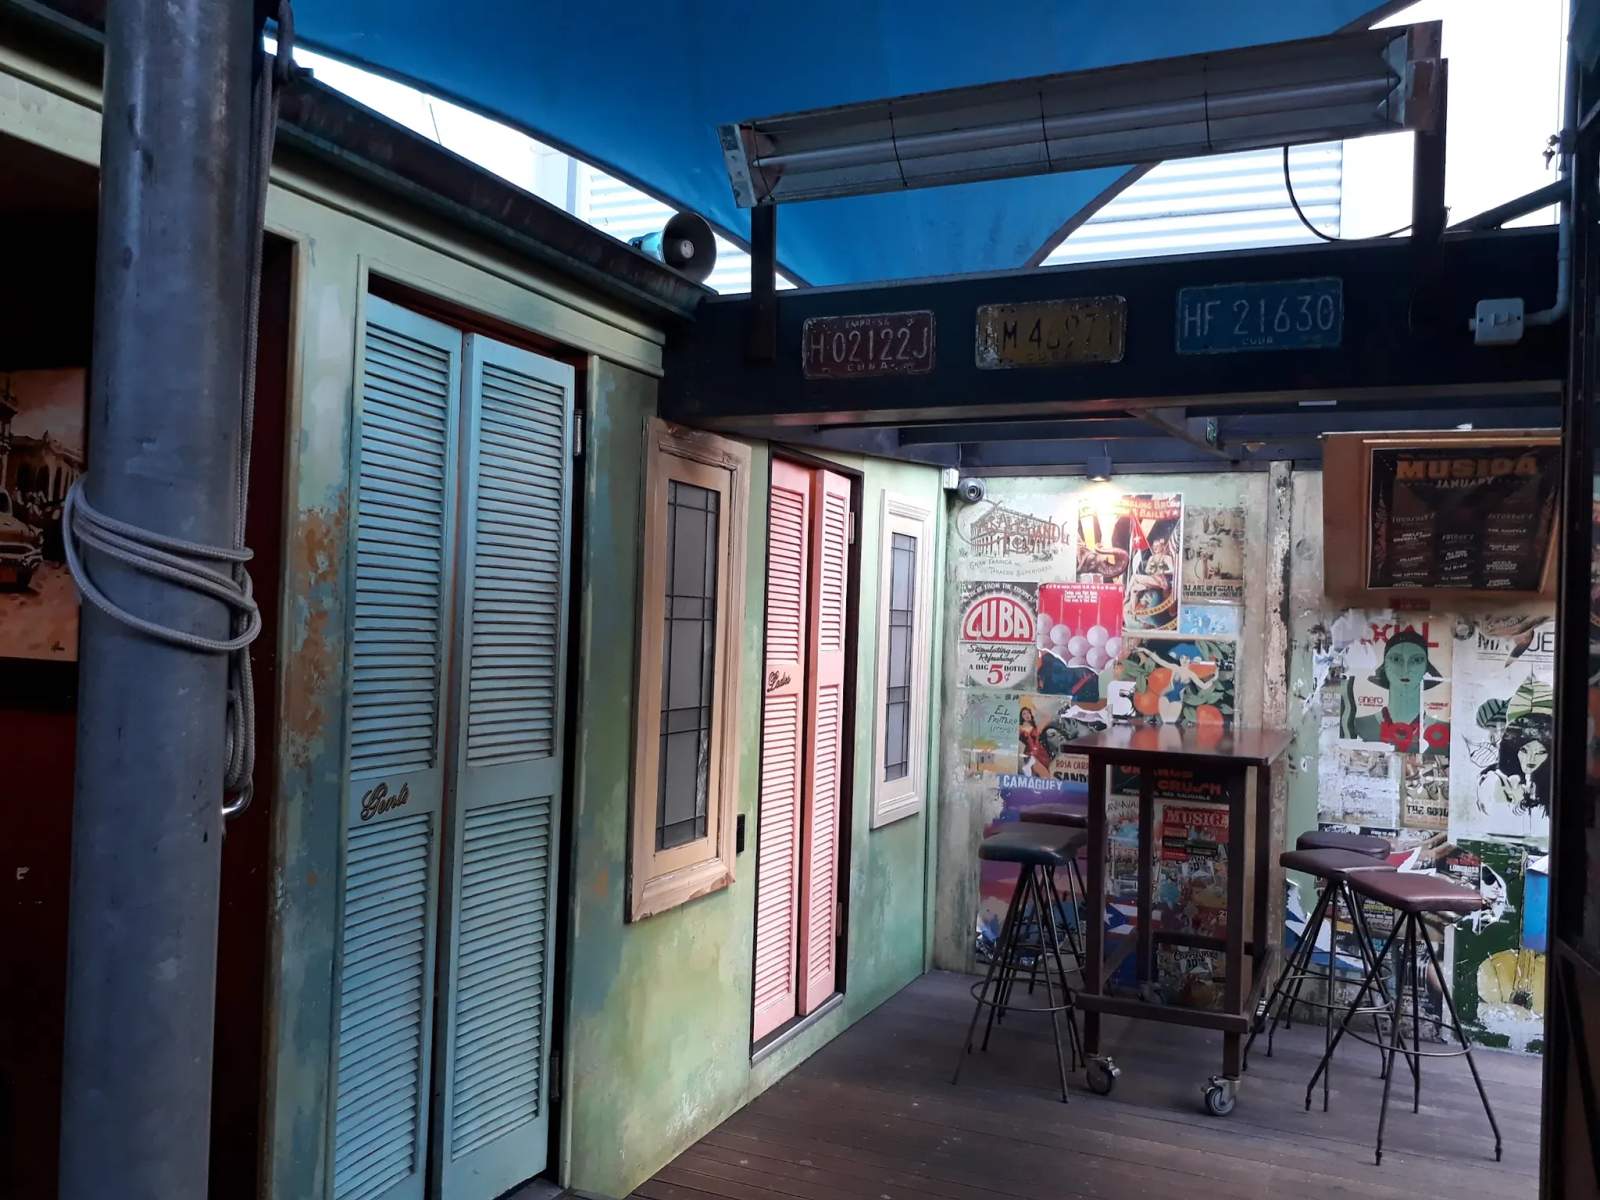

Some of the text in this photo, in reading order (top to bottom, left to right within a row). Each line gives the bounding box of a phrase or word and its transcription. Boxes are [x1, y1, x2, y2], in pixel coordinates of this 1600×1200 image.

[1184, 294, 1335, 336] HF 21630
[965, 600, 1030, 638] CUBA
[1053, 772, 1087, 783] SAND
